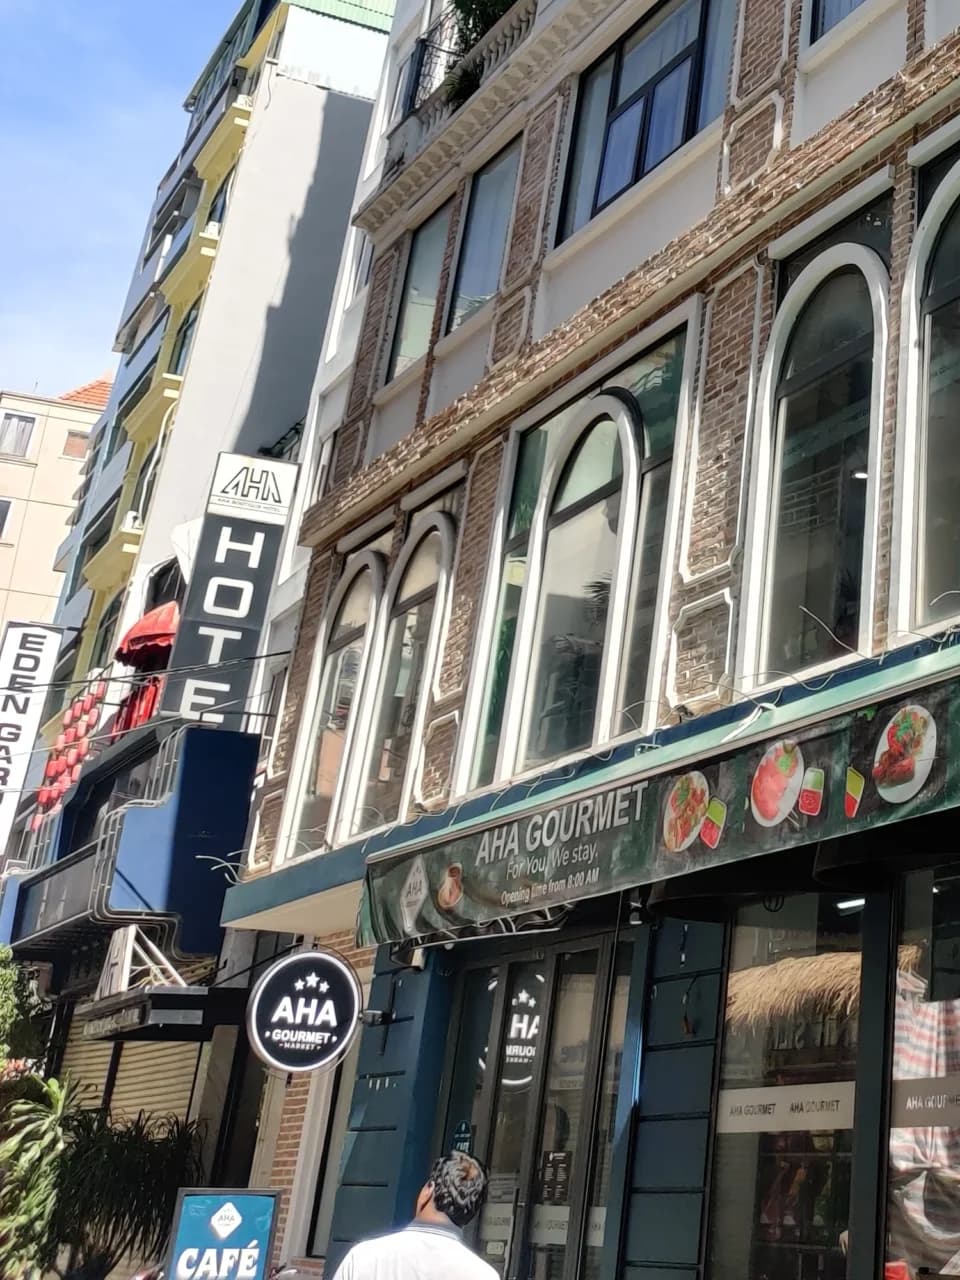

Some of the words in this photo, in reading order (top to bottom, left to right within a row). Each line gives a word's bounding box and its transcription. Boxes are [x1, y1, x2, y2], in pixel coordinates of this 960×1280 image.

[220, 466, 282, 504] AHA
[2, 633, 47, 715] EDEN
[475, 822, 519, 866] AHA
[525, 781, 648, 852] GOURMET
[506, 858, 525, 881] For
[552, 847, 569, 868] We
[406, 879, 423, 897] AHA
[501, 886, 530, 905] Opening
[548, 877, 567, 893] from
[567, 872, 585, 889] 8:00
[586, 867, 600, 884] AM
[271, 996, 338, 1028] AHA
[272, 1028, 331, 1045] GOURMET
[744, 1102, 777, 1116] GOURMET
[789, 1101, 804, 1113] AHA
[906, 1095, 923, 1110] AHA
[176, 1238, 260, 1280] CAFÉ
